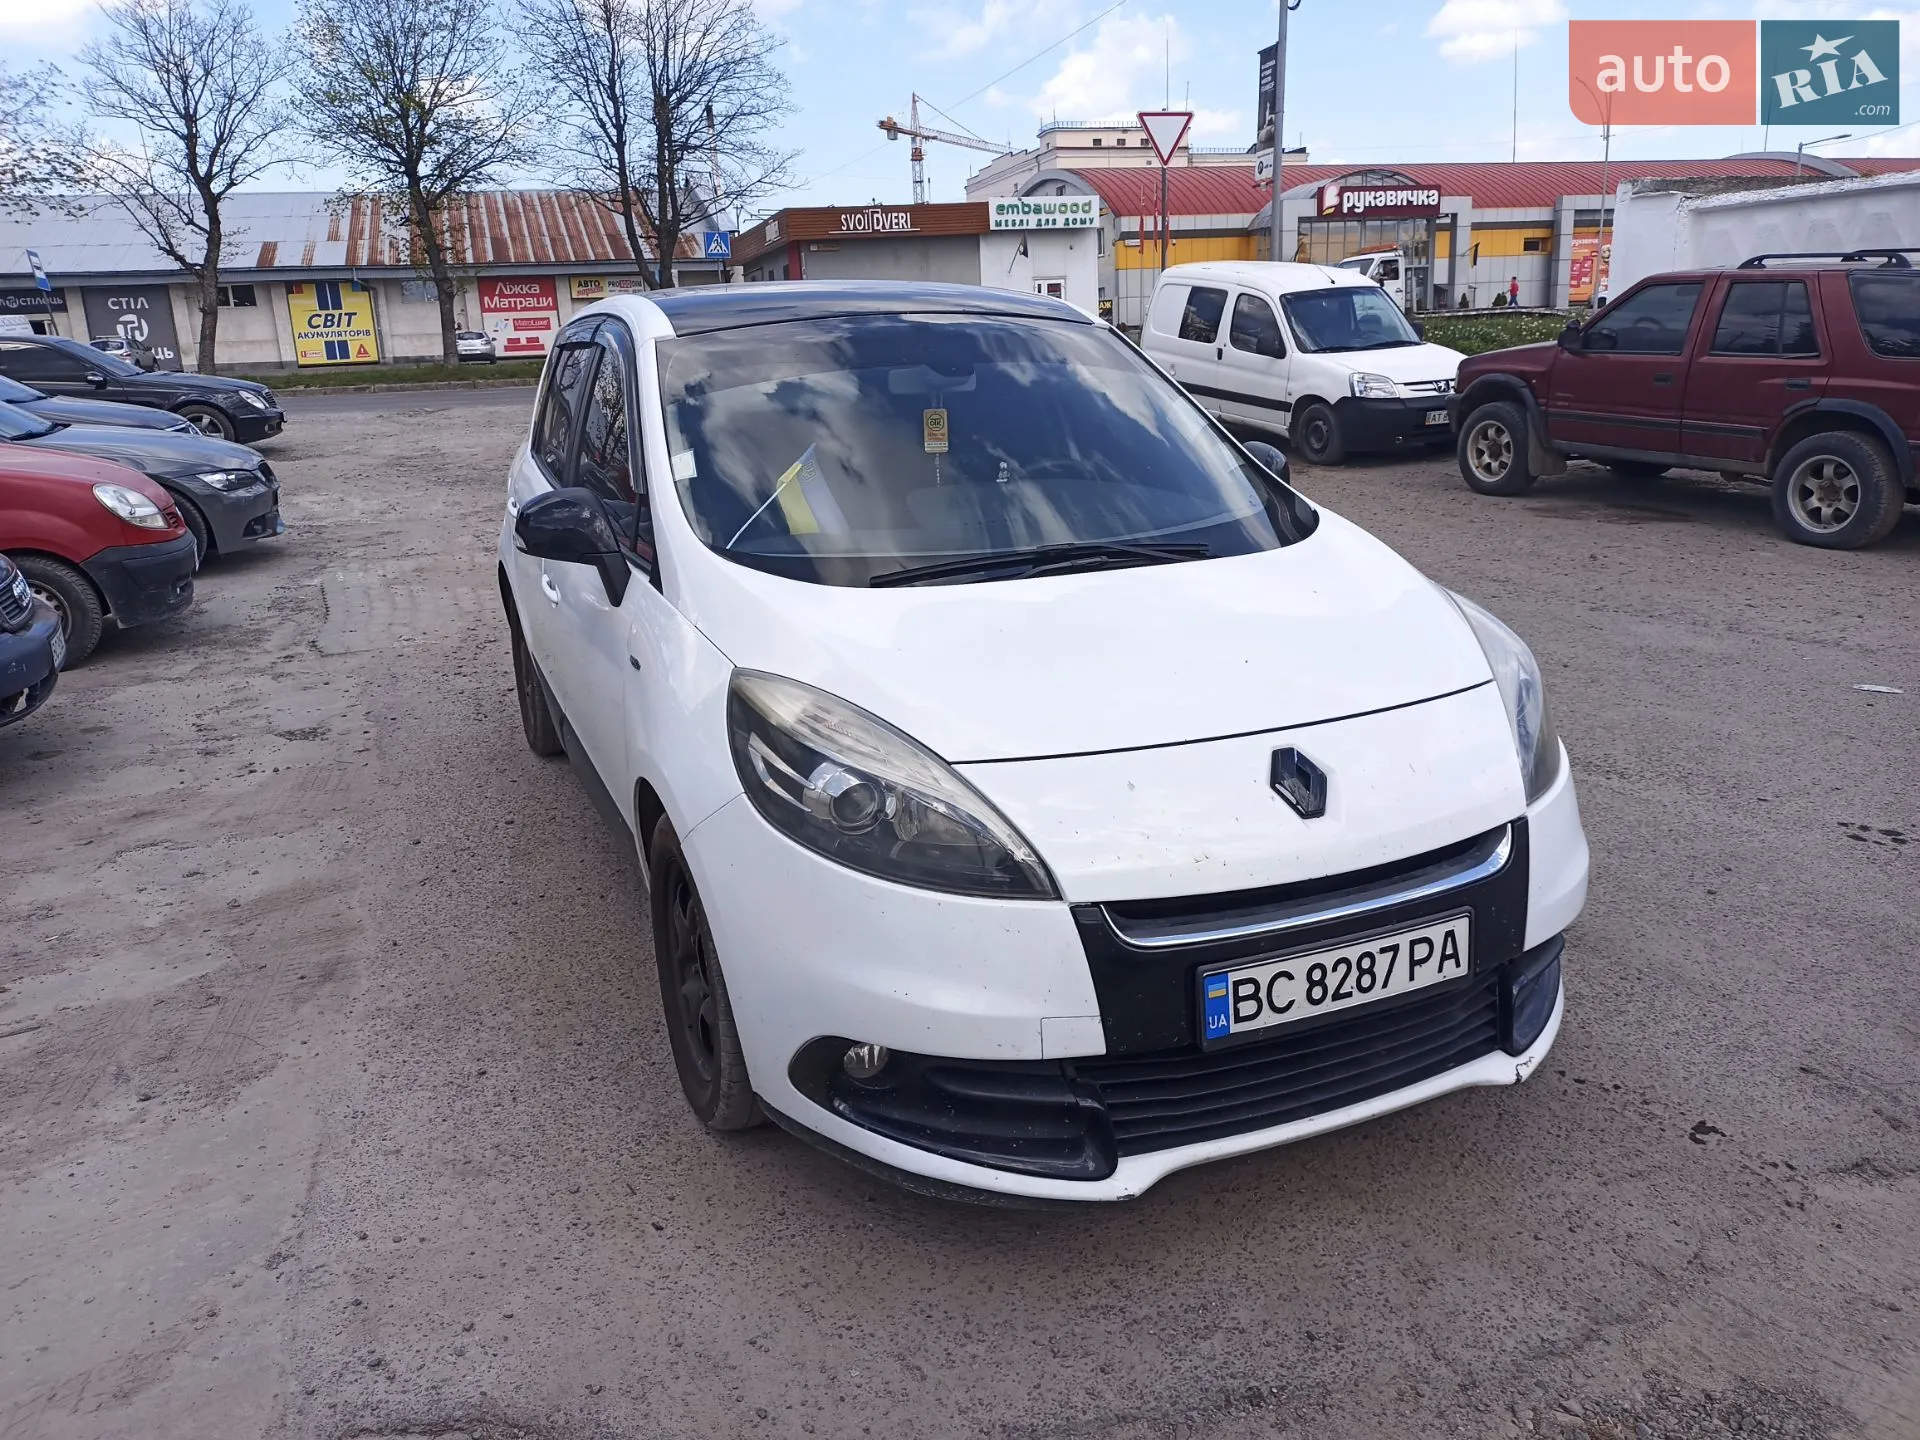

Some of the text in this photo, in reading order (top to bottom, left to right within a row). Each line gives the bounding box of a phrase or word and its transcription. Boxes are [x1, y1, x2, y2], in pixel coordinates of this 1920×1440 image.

[995, 200, 1092, 215] embawood
[1342, 189, 1439, 213] рукавичка
[994, 217, 1095, 228] МЕБЛІ ДЛЯ ДОМУ
[495, 281, 540, 294] Ліжка
[577, 279, 601, 288] АВТО
[483, 296, 553, 310] Матраци
[307, 312, 357, 329] СВІТ
[297, 329, 371, 340] АКУМУЛЯТОРІВ
[1231, 928, 1462, 1024] BC 8287 PA
[1208, 1013, 1228, 1030] UA
